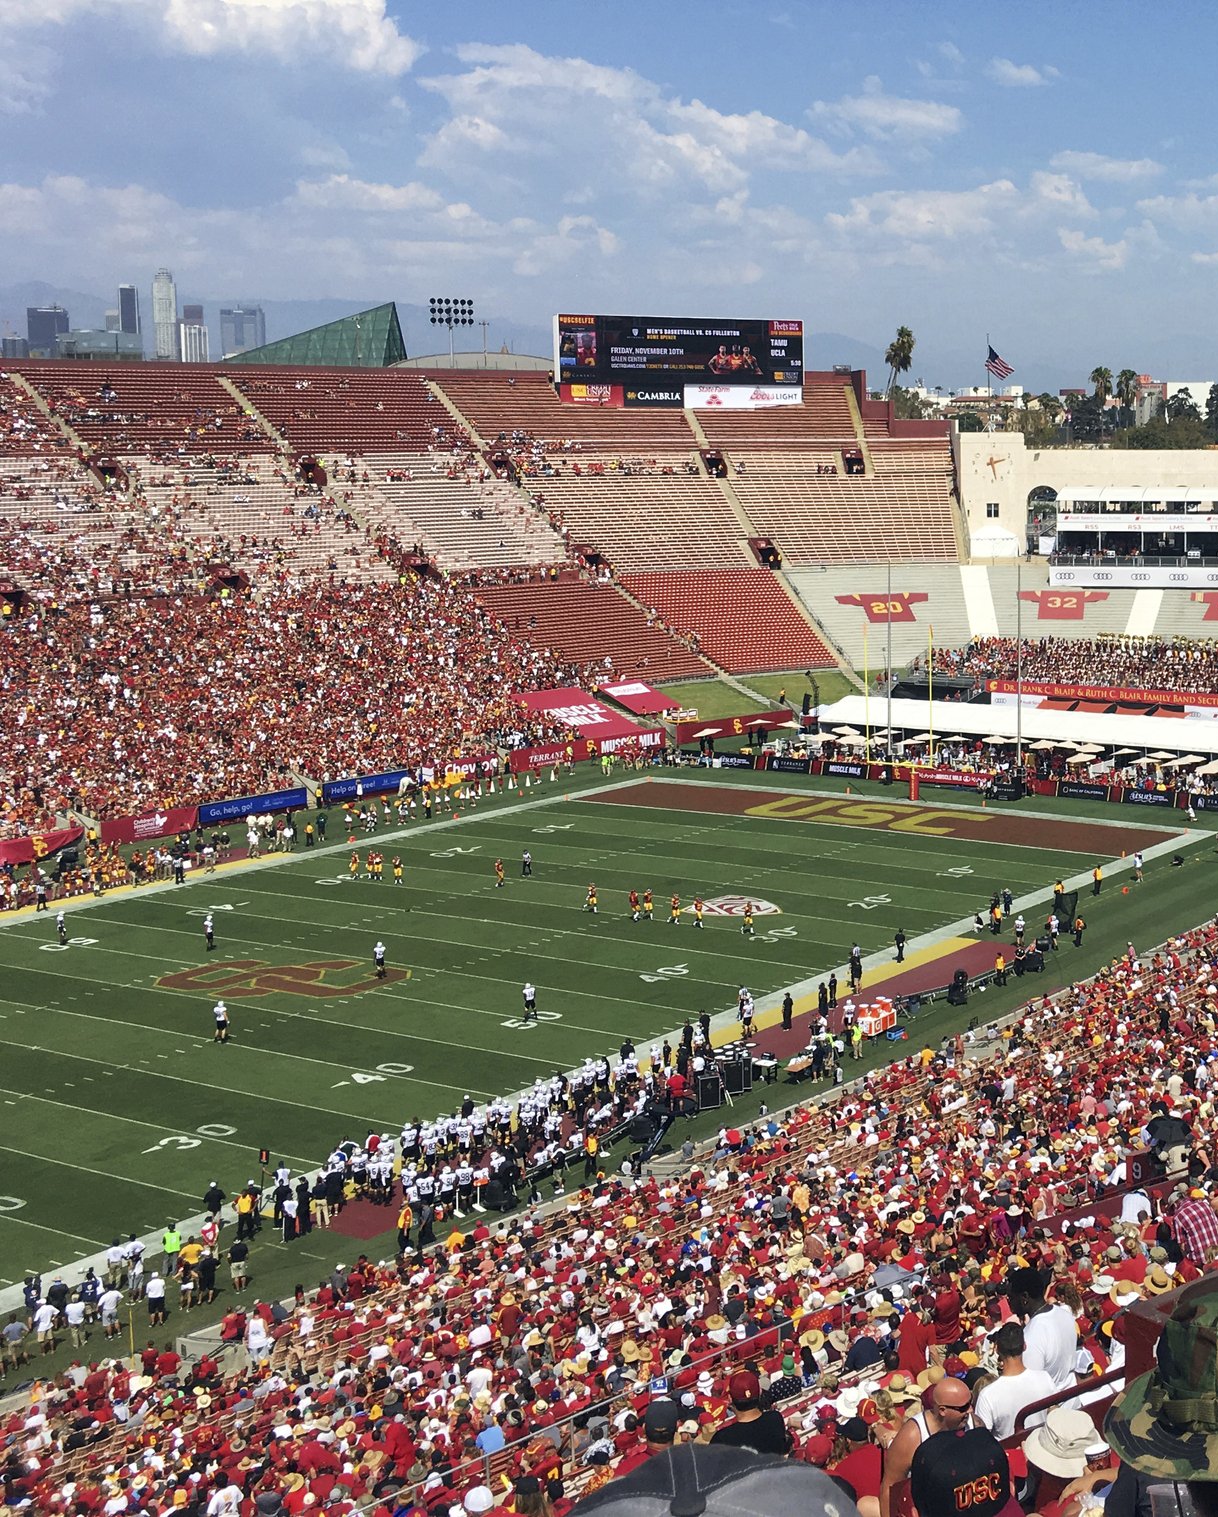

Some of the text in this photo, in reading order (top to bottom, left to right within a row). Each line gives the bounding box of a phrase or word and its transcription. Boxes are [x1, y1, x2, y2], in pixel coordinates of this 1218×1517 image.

[770, 338, 788, 347] TAMU
[610, 346, 634, 356] FRIDAY,
[634, 347, 668, 355] NOVEMBER
[637, 392, 681, 400] CAMBRIA
[872, 601, 903, 614] 20
[1048, 597, 1078, 608] 32
[1078, 688, 1084, 696] &
[1086, 689, 1107, 698] RUTH
[1120, 692, 1141, 700] BLAIR
[1144, 693, 1171, 702] FAMILY
[1173, 694, 1196, 703] BAND
[560, 714, 610, 726] MILK
[734, 718, 743, 734] SC
[638, 732, 662, 747] MILK
[829, 764, 861, 775] MUSCLE MILK
[331, 786, 346, 794] Help
[210, 808, 222, 816] Go,
[223, 805, 240, 814] help,
[242, 802, 253, 812] go!
[743, 796, 996, 835] USC
[32, 836, 49, 858] SC
[936, 866, 974, 878] 10
[846, 895, 892, 910] 20
[748, 927, 799, 944] 30
[38, 936, 99, 952] 50
[638, 966, 690, 983] 40
[500, 1011, 563, 1030] 50
[351, 1062, 415, 1084] 40
[158, 1123, 238, 1150] 30
[1132, 1162, 1142, 1180] 9
[953, 1472, 1002, 1512] USC
